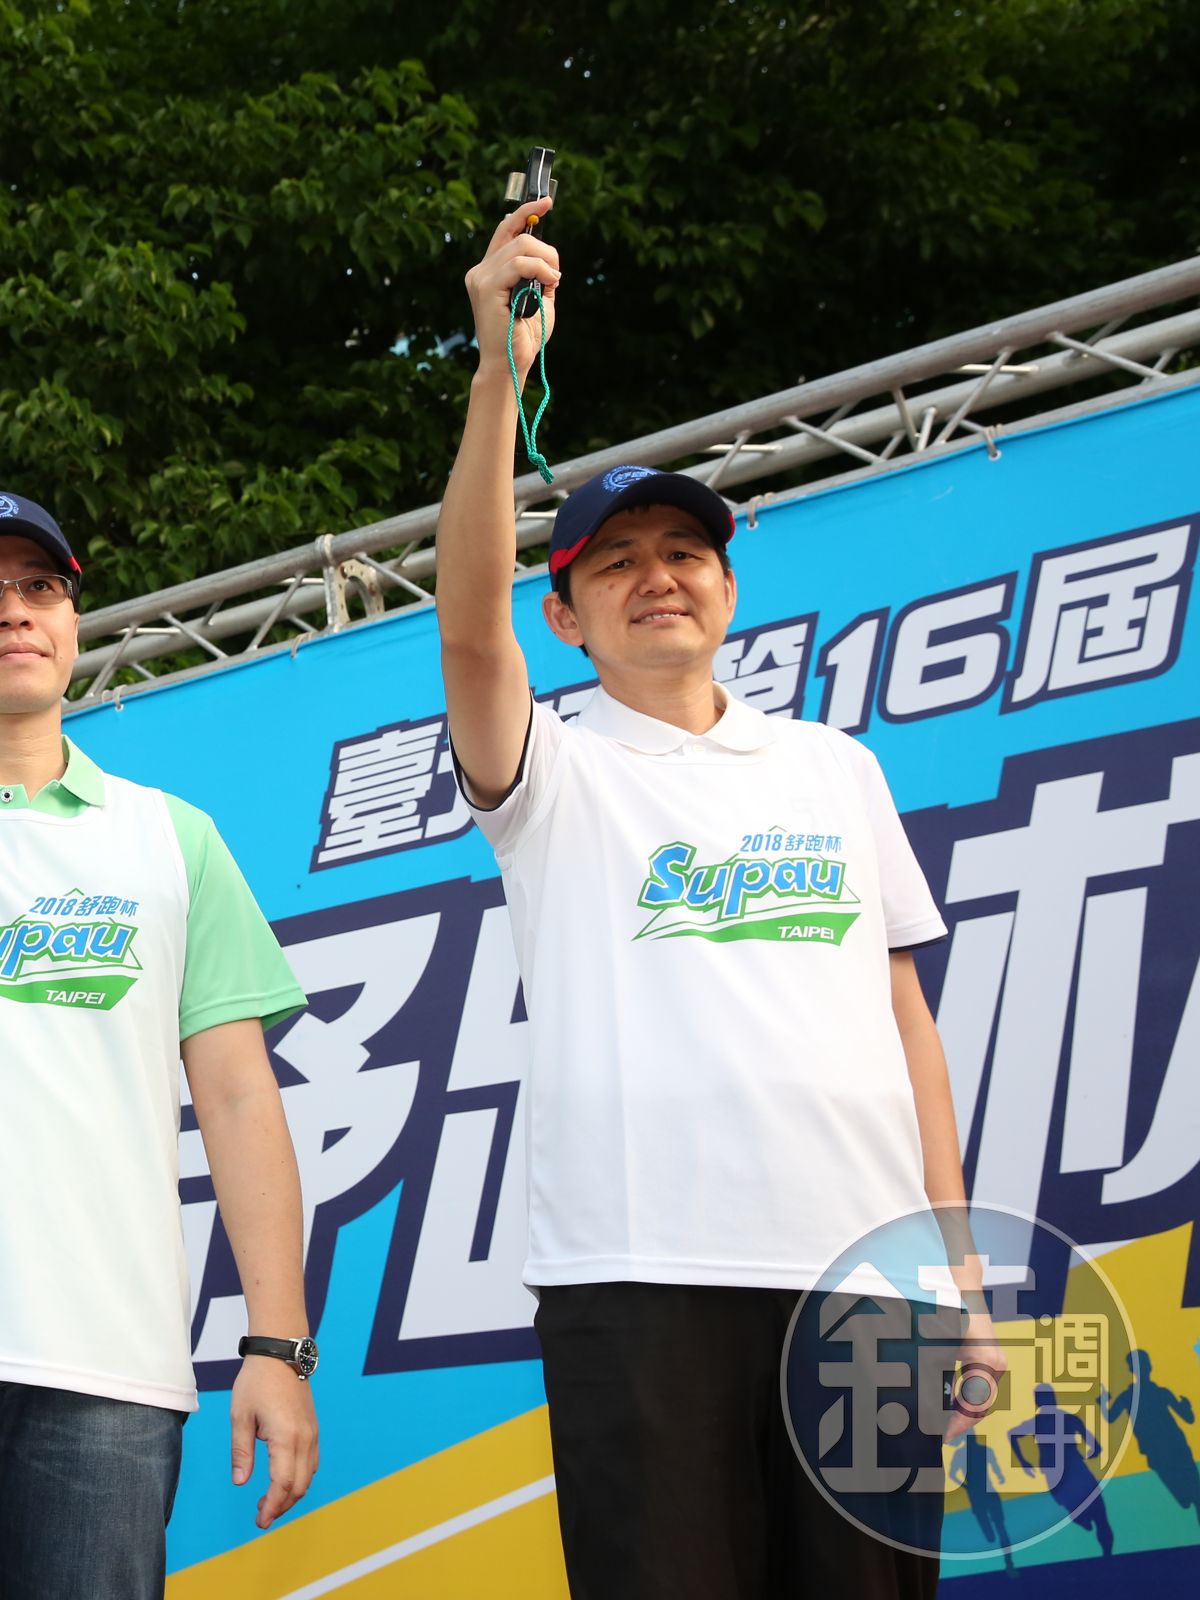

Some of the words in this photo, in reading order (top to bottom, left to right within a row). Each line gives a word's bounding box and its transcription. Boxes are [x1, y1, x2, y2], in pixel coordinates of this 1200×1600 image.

[640, 843, 844, 918] Supau
[777, 925, 835, 940] TAIPEI
[45, 989, 107, 1005] TAIPEI
